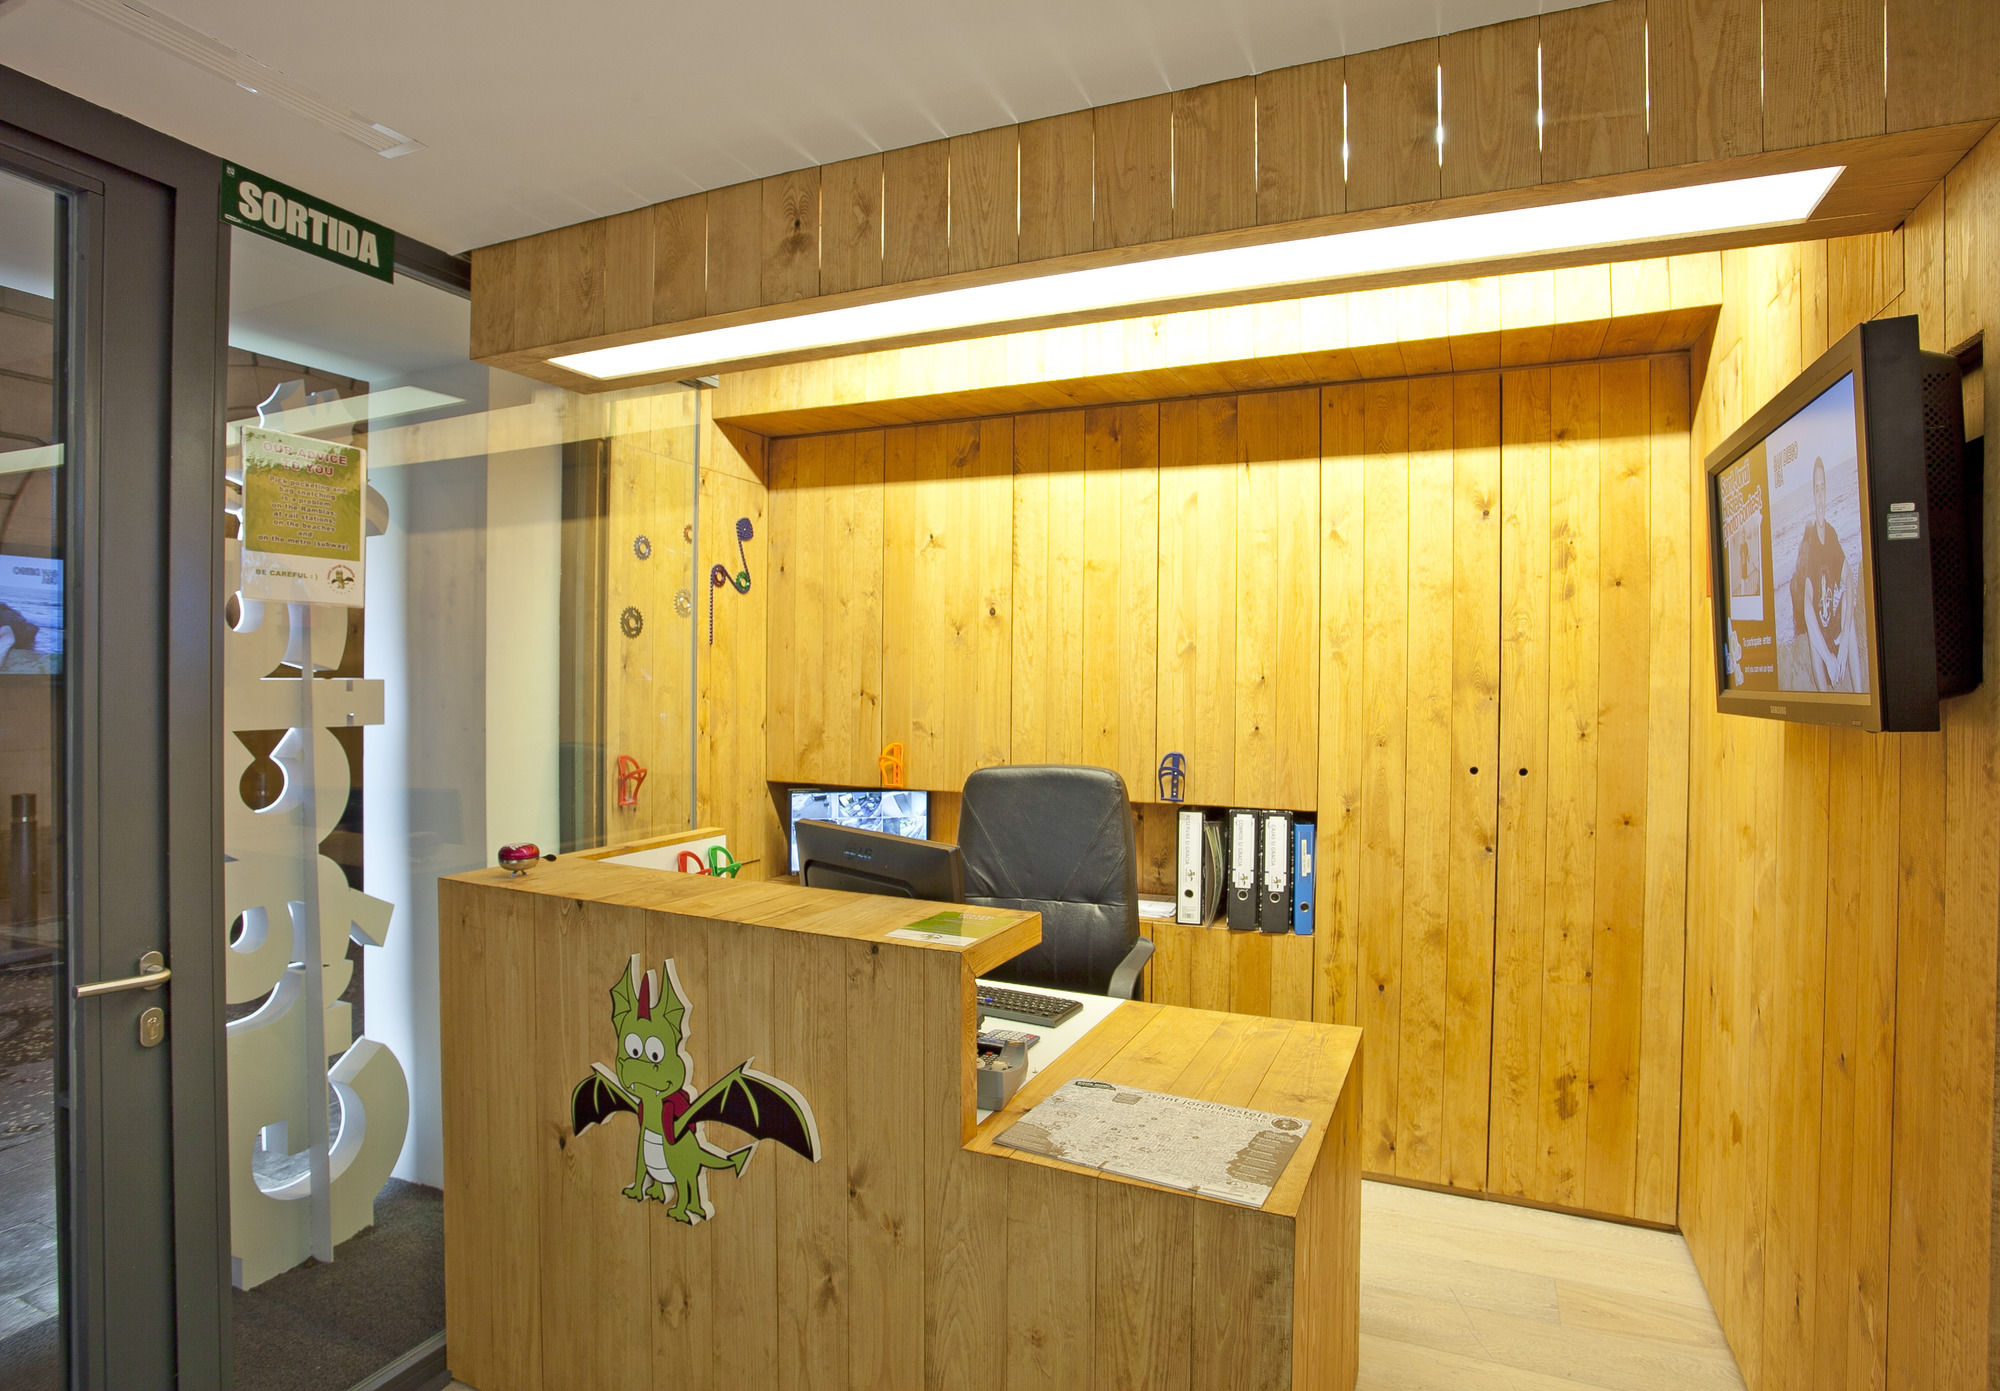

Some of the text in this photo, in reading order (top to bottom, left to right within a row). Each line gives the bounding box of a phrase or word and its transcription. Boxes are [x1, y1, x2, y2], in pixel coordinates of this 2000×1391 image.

[238, 180, 380, 268] SORTIDA
[296, 447, 347, 465] ADVICE
[305, 463, 334, 477] YOU
[302, 522, 336, 532] beaches
[287, 538, 312, 546] metro
[255, 568, 266, 576] BE
[269, 569, 309, 579] CAREFUL
